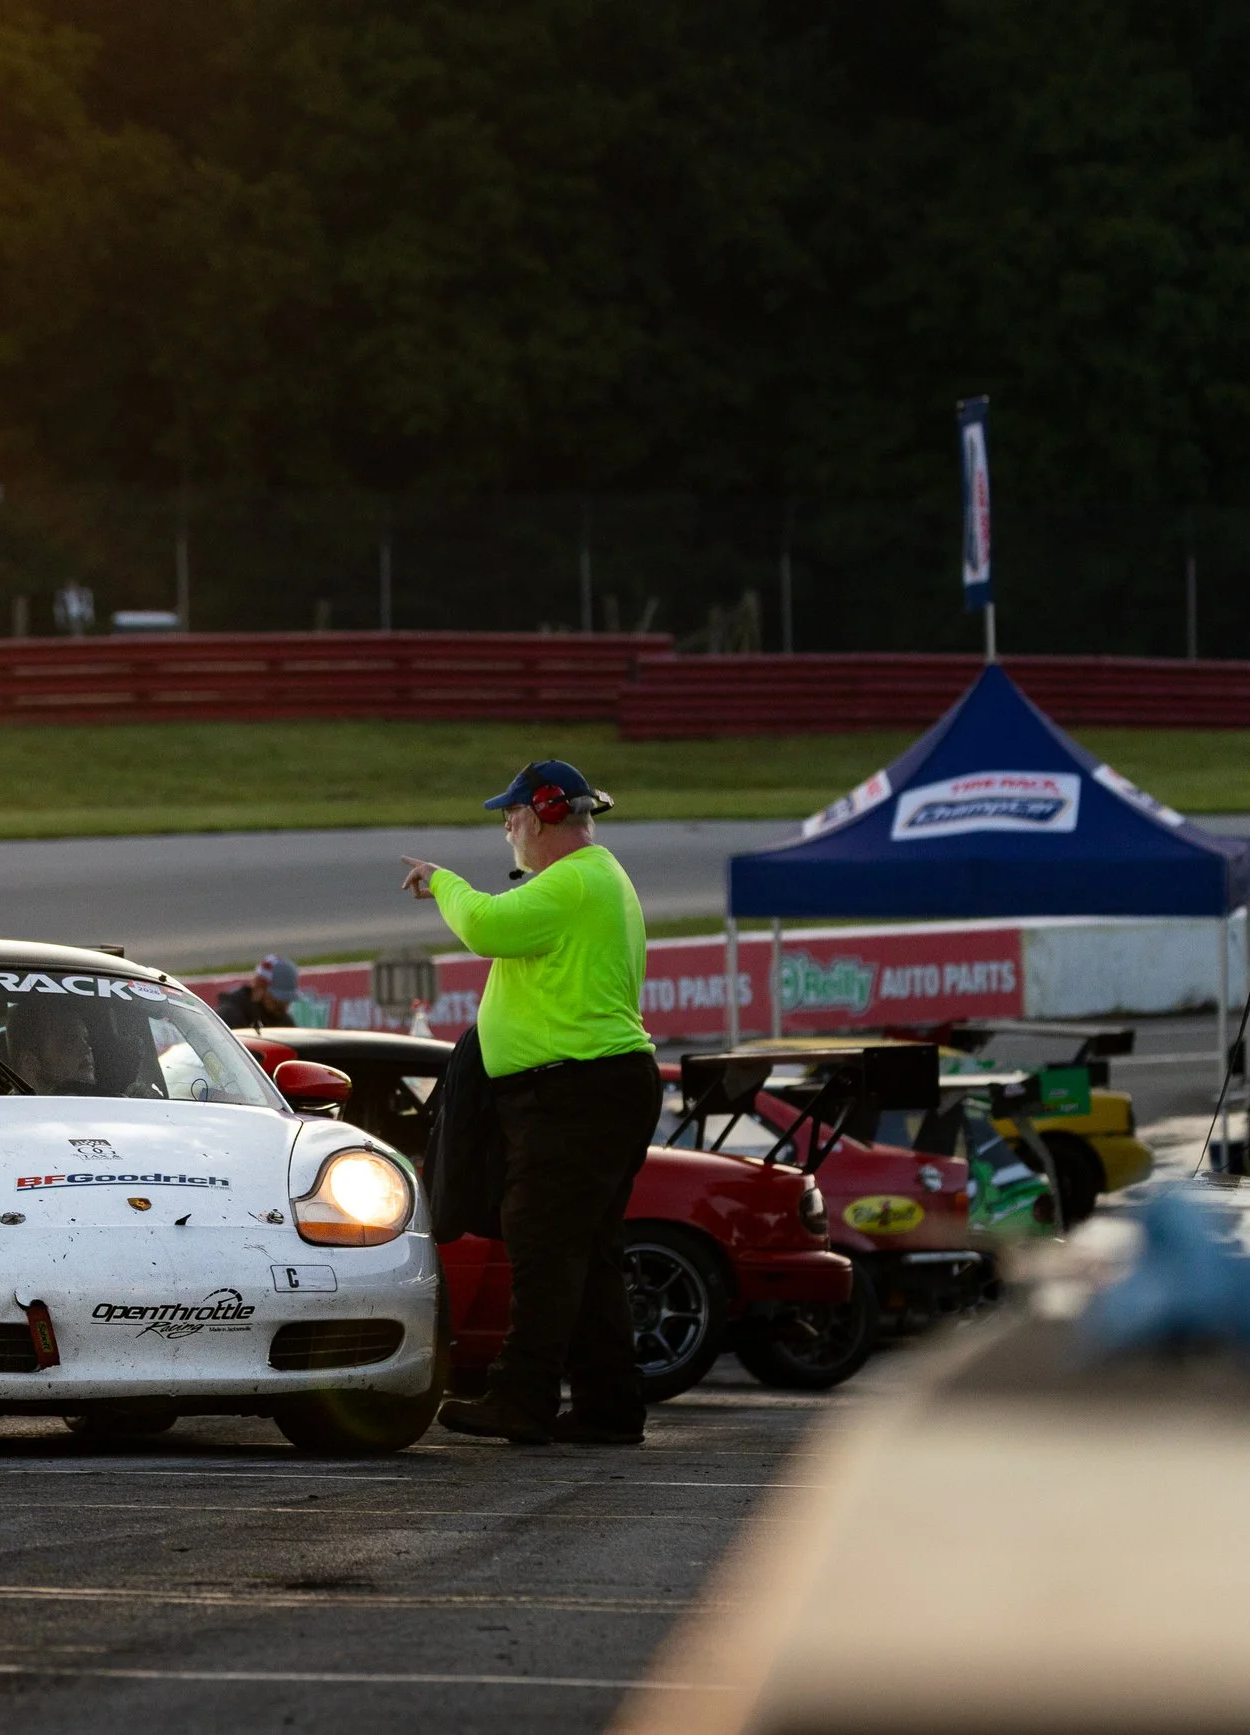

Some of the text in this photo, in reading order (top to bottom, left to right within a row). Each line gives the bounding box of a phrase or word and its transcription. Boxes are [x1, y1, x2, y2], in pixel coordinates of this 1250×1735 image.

[880, 965, 939, 998] AUTO
[943, 961, 1015, 993] PARTS
[16, 1173, 230, 1188] BFGoodrich
[286, 1268, 299, 1288] C
[91, 1302, 255, 1322] OpenThrottle
[135, 1321, 206, 1340] Racing
